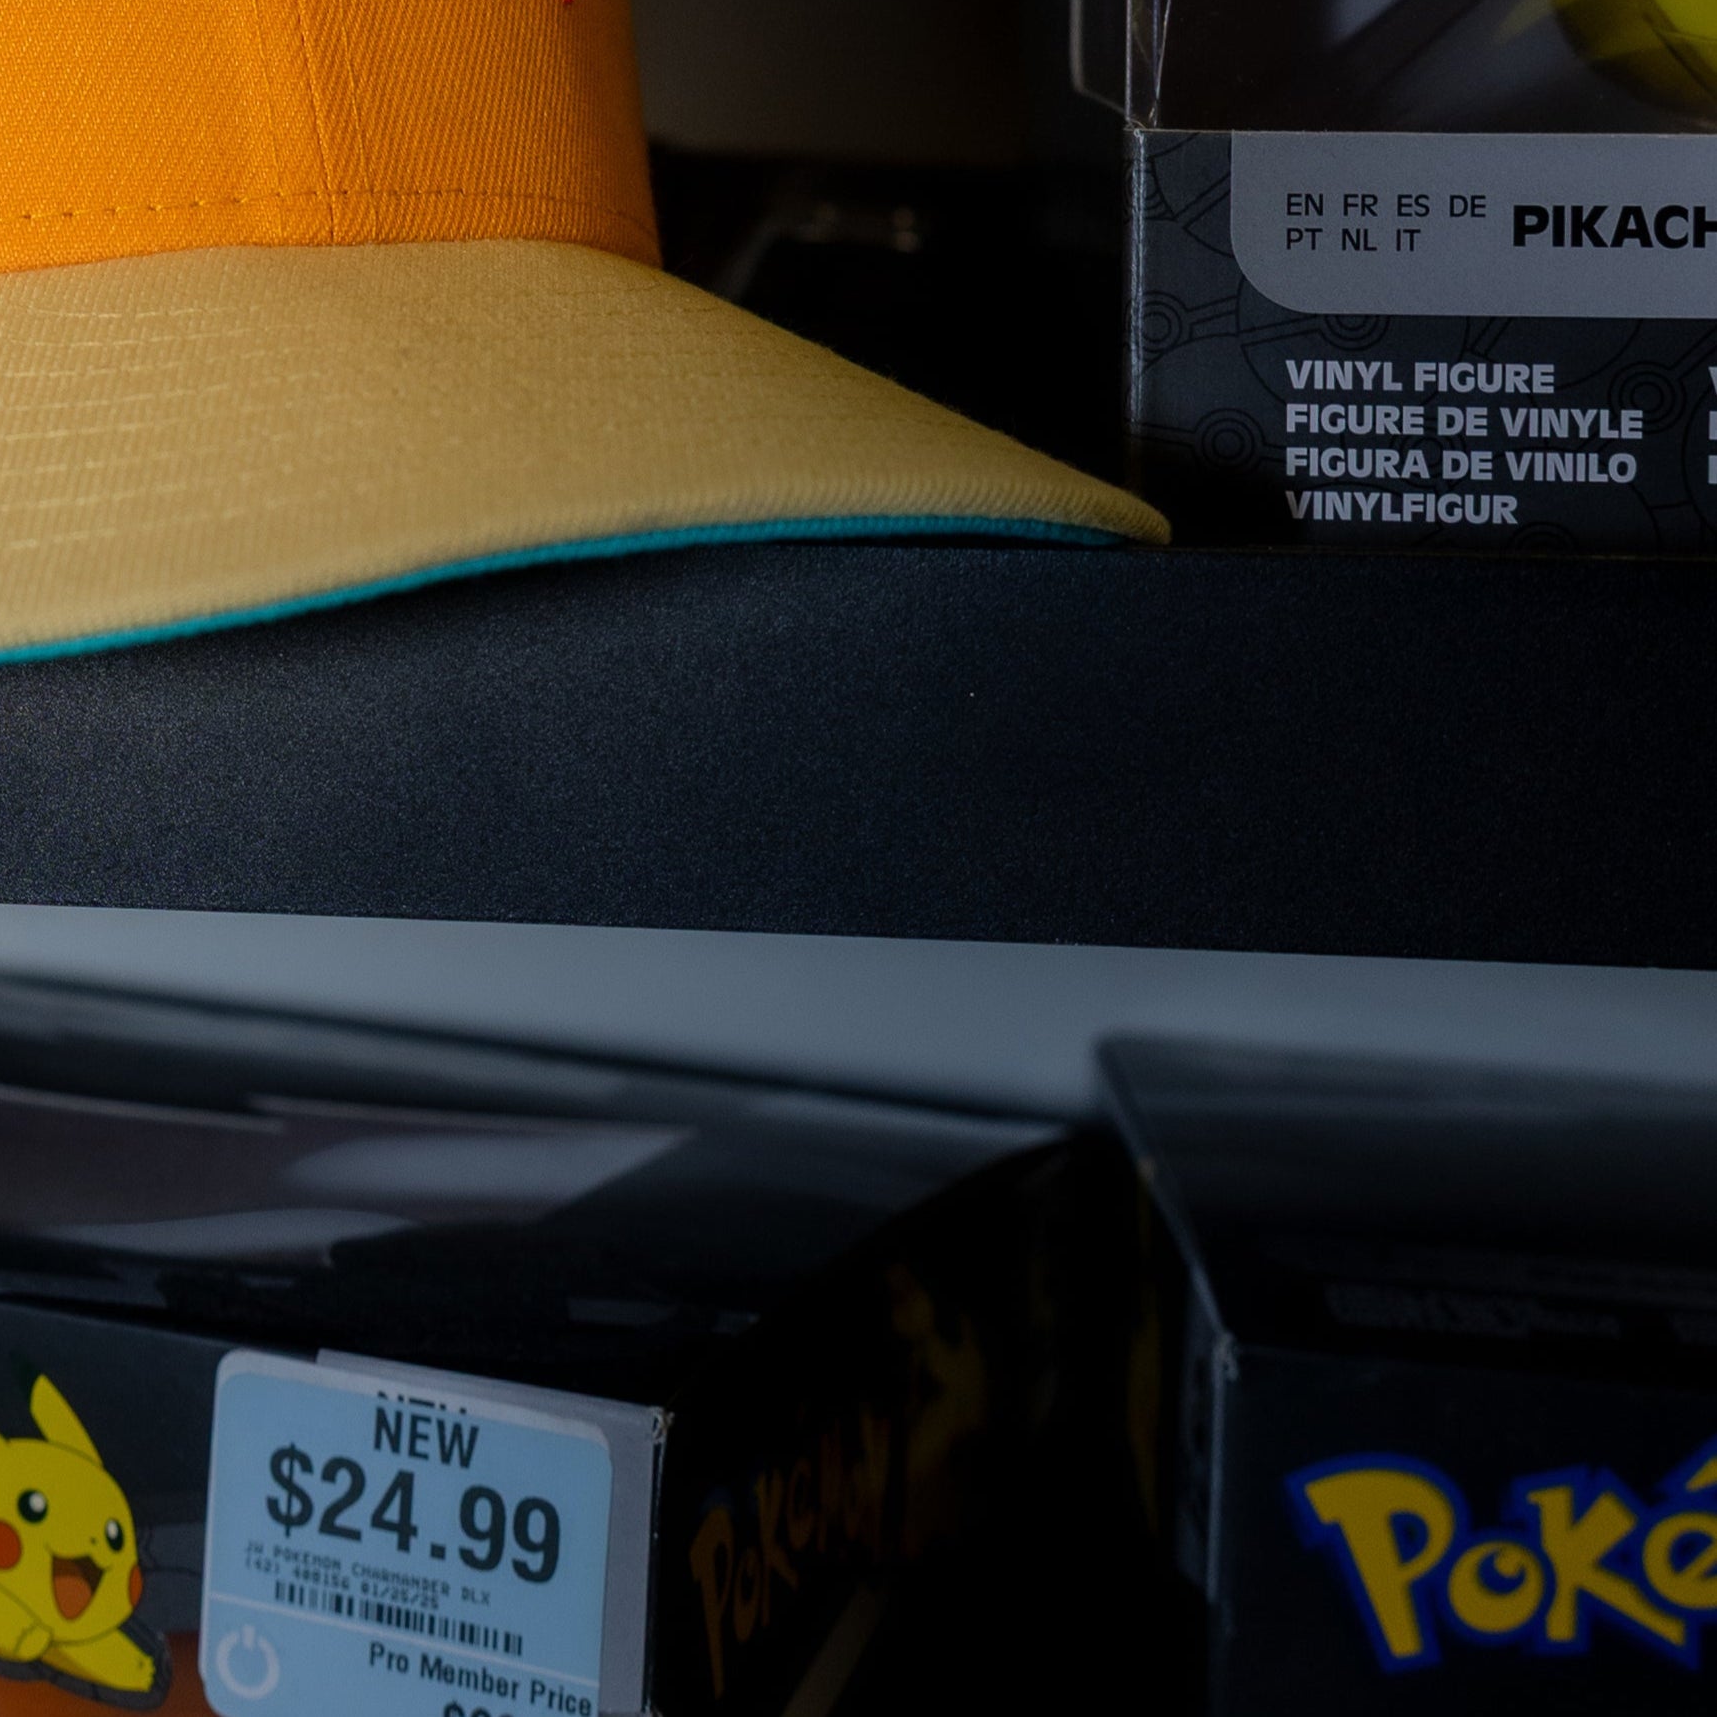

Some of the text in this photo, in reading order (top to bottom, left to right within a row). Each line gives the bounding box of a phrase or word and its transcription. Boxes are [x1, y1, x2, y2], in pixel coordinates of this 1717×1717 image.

[1285, 193, 1487, 218] EN FR ES DE
[1285, 228, 1421, 252] PT NL IT
[1286, 359, 1555, 394] VINYL FIGURE
[1286, 404, 1644, 440] FIGURE DE VINYLE
[1286, 447, 1637, 484] FIGURA DE VINILO
[1286, 491, 1519, 525] VINYLFIGUR
[373, 1405, 481, 1470] NEW
[265, 1442, 562, 1584] $24.99
[369, 1640, 411, 1674] Pro
[419, 1652, 520, 1702] Member
[530, 1679, 593, 1717] Price
